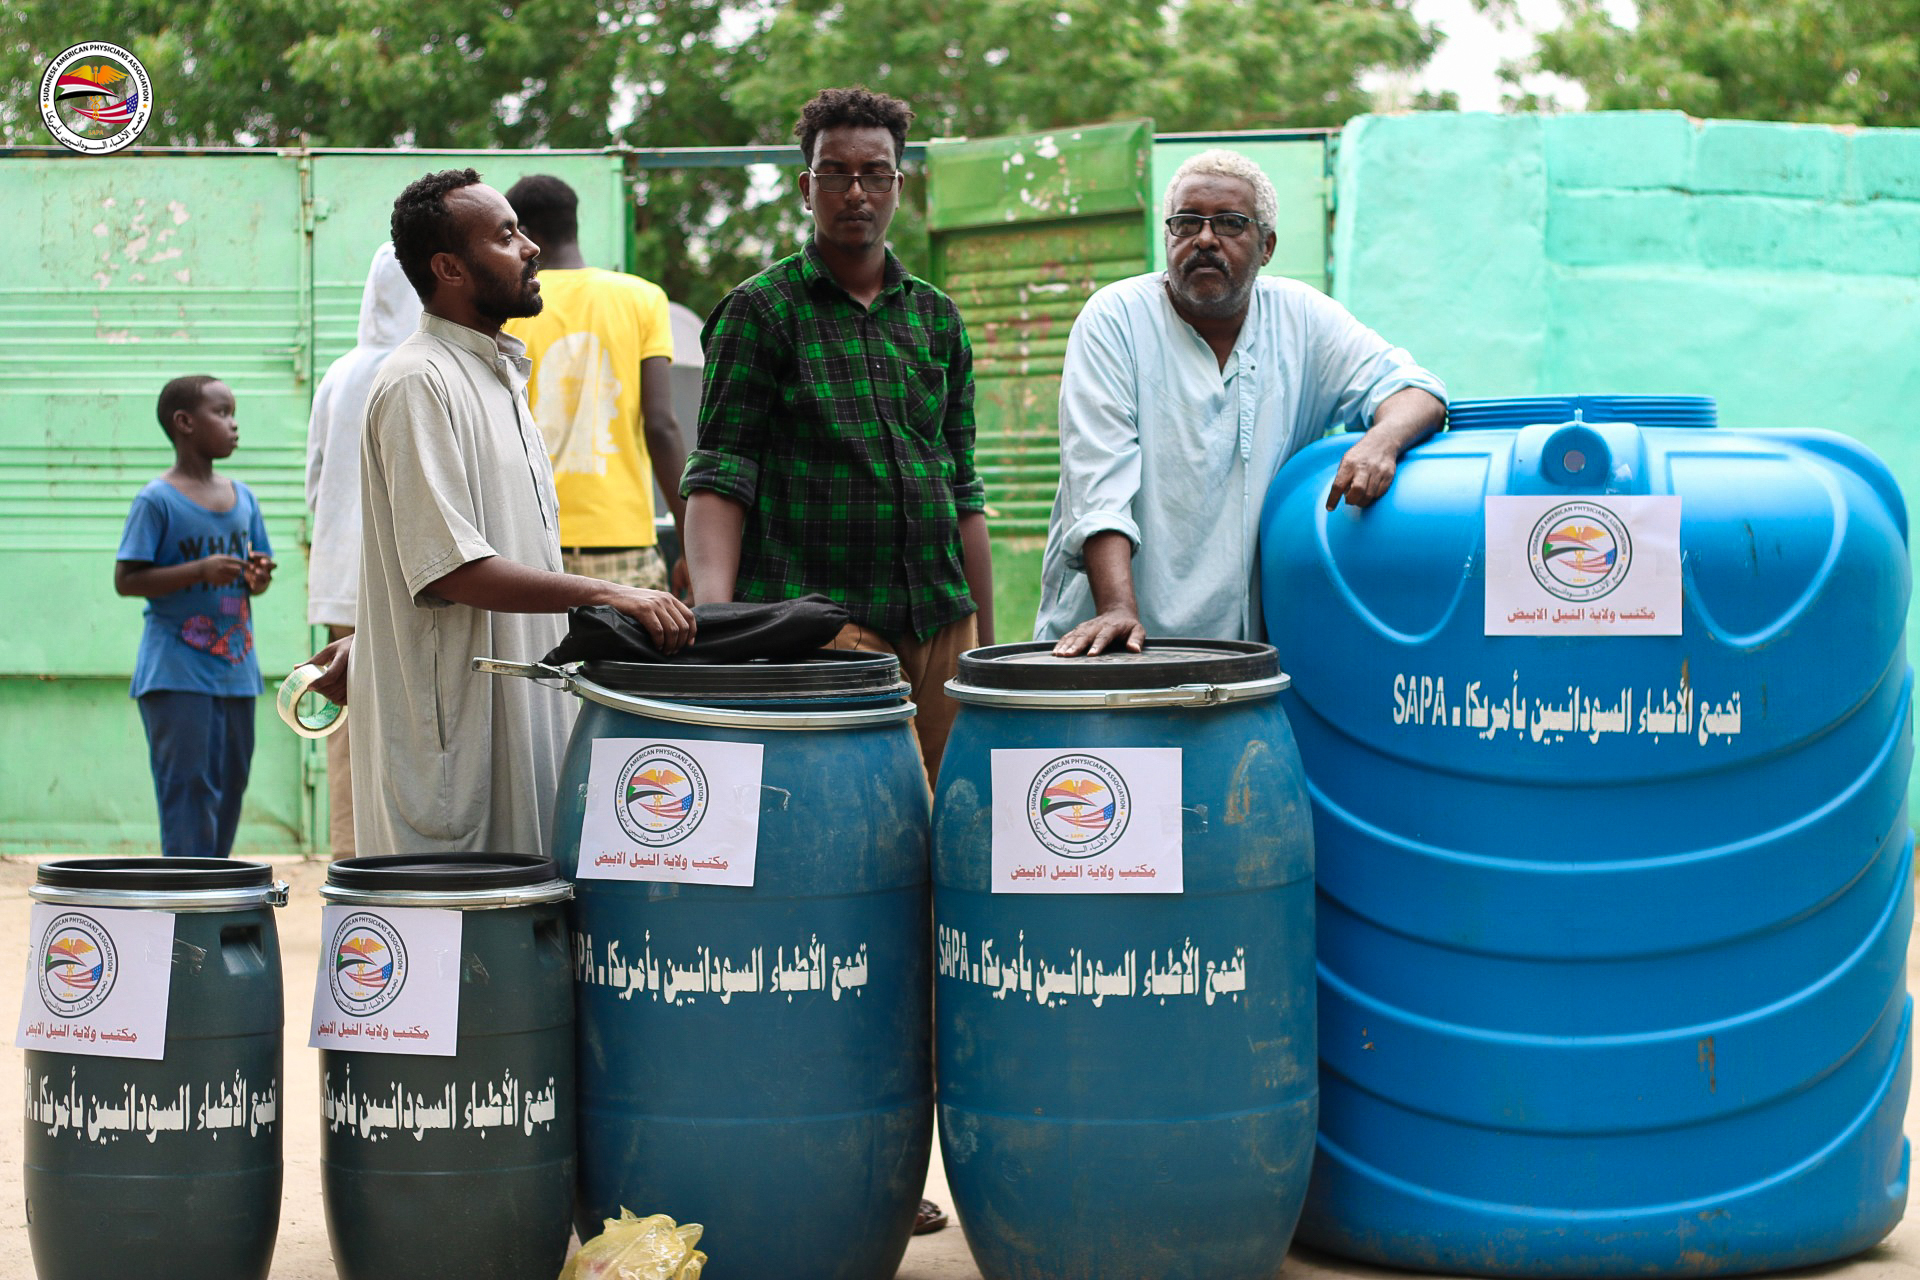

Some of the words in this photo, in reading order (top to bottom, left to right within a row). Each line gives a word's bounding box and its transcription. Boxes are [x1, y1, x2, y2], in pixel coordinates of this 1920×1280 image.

[1543, 506, 1573, 526] AMERICAN
[1574, 505, 1609, 520] PHYSICIANS
[1551, 607, 1585, 624] النيل
[1589, 607, 1615, 624] ولاية
[1620, 606, 1655, 624] مكتب
[1393, 673, 1447, 726] SAPA
[1465, 669, 1526, 741] بأمريكا
[1531, 685, 1632, 746] السودانيين
[1637, 676, 1694, 745] الأطباء
[1698, 691, 1742, 747] تجمع
[618, 767, 632, 798] SUDANESE
[630, 749, 655, 769] AMERICAN
[655, 748, 688, 766] PHYSICIANS
[687, 762, 704, 802] ASSOCIATION
[1031, 777, 1044, 810] SUDANESE
[1042, 759, 1071, 780] AMERICAN
[1071, 759, 1107, 775] PHYSICIANS
[1106, 771, 1126, 810] ASSOCIATION
[595, 850, 626, 868] الابيض
[629, 852, 660, 869] النيل
[663, 854, 687, 870] ولاية
[692, 856, 729, 871] مكتب
[1011, 864, 1046, 881] الابيض
[1051, 864, 1083, 881] النيل
[1087, 864, 1114, 881] ولاية
[1119, 864, 1156, 881] مكتب
[48, 917, 69, 938] AMERICAN
[69, 916, 99, 934] PHYSICIANS
[97, 931, 114, 972] ASSOCIATION
[338, 916, 359, 937] AMERICAN
[358, 916, 388, 933] PHYSICIANS
[386, 930, 404, 970] ASSOCIATION
[571, 931, 595, 985] PA
[608, 929, 660, 1002] بأمريكا
[769, 933, 825, 1003] الأطباء
[938, 923, 970, 982] SAPA
[981, 929, 1033, 1003] بأمريكا
[663, 946, 763, 1007] السودانيين
[831, 942, 868, 1002] تجمع
[1036, 947, 1136, 1009] السودانيين
[1142, 936, 1200, 1007] الأطباء
[1205, 946, 1246, 1006] تجمع
[46, 1023, 69, 1039] النيل
[73, 1024, 96, 1043] ولاية
[101, 1028, 138, 1043] مكتب
[338, 1022, 362, 1038] النيل
[365, 1022, 389, 1040] ولاية
[393, 1025, 430, 1041] مكتب
[39, 1065, 83, 1140] بأمريكا
[87, 1082, 191, 1145] السودانيين
[196, 1068, 247, 1142] الأطباء
[250, 1077, 277, 1138] تجمع
[324, 1062, 357, 1136] بأمريكا
[360, 1081, 456, 1143] السودانيين
[463, 1068, 518, 1140] الأطباء
[524, 1076, 556, 1137] تجمع
